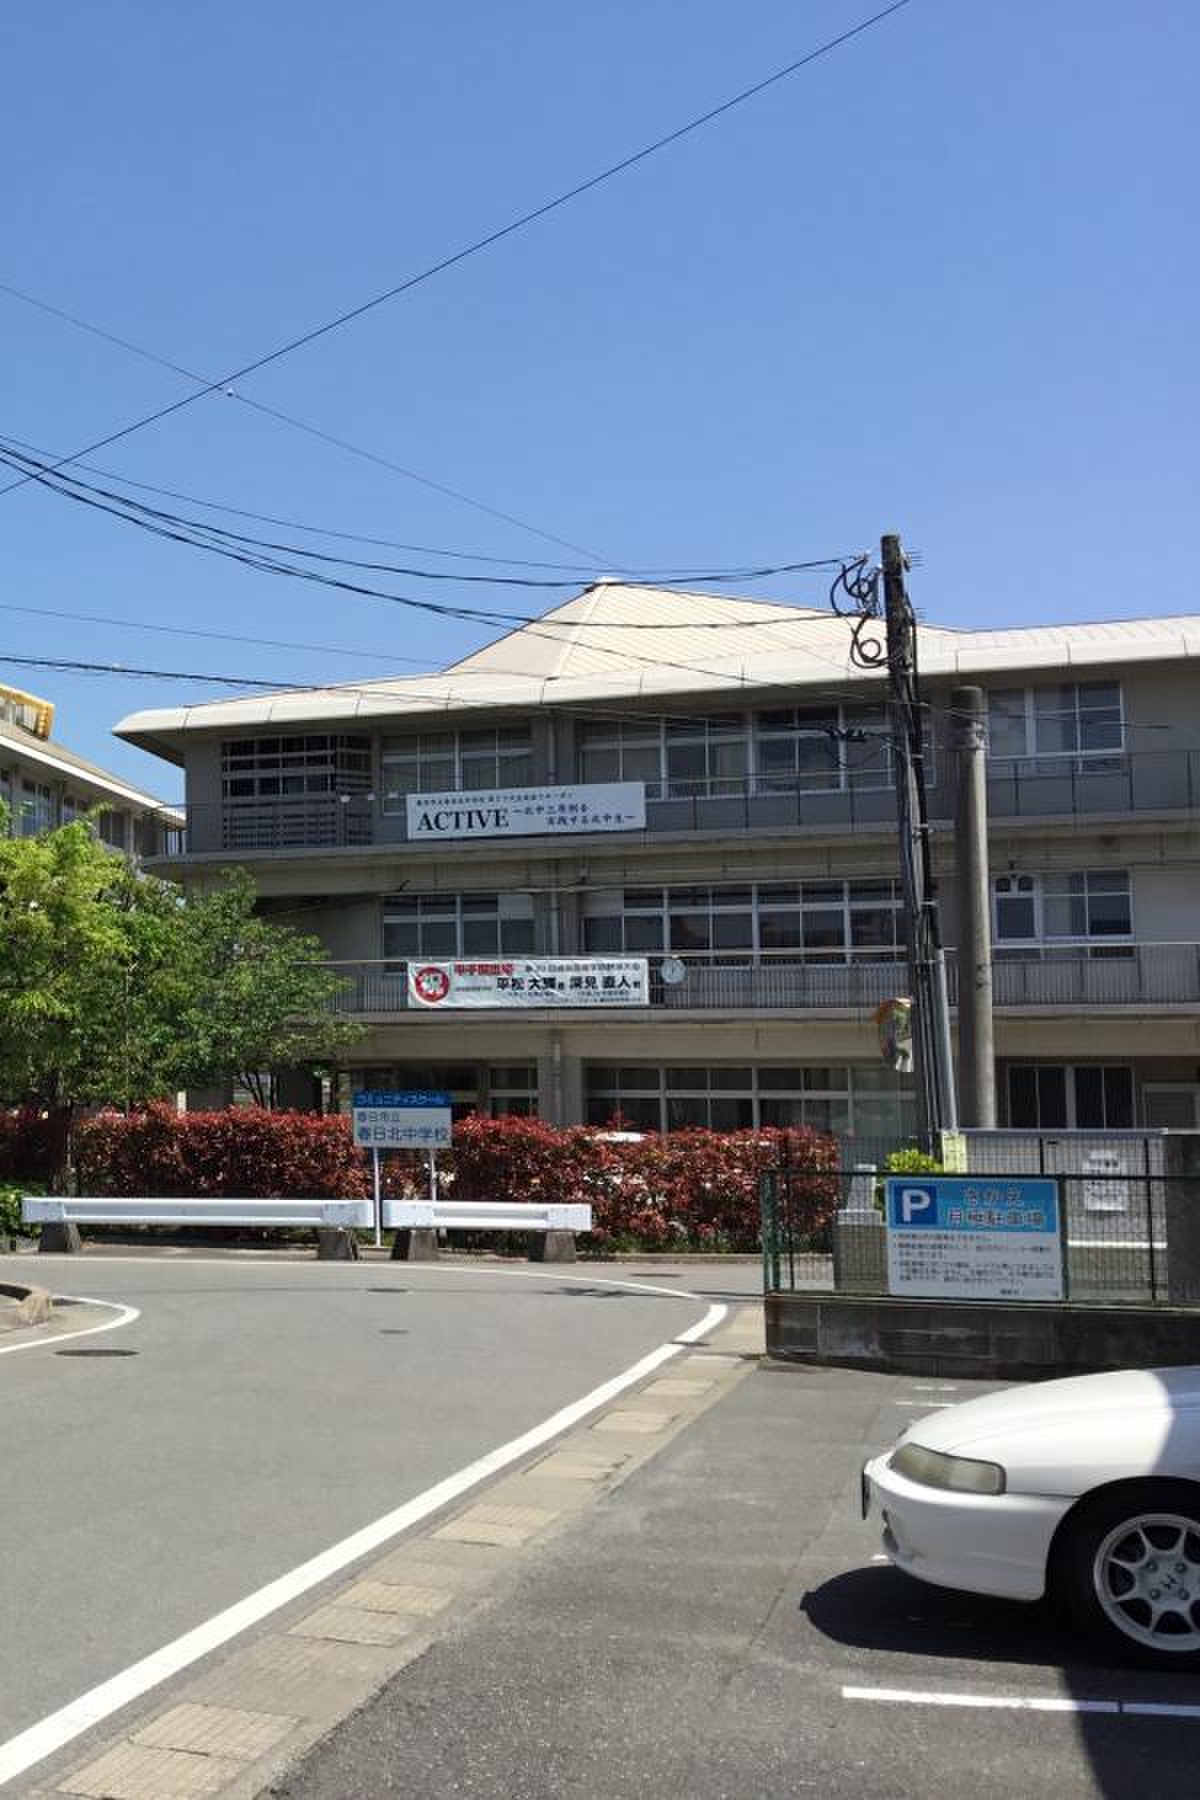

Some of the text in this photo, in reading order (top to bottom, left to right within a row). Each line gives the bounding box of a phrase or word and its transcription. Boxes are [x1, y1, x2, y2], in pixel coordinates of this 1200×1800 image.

[416, 809, 509, 831] ACTIVE
[357, 1127, 449, 1142] 春日北中学校
[901, 1189, 931, 1223] P
